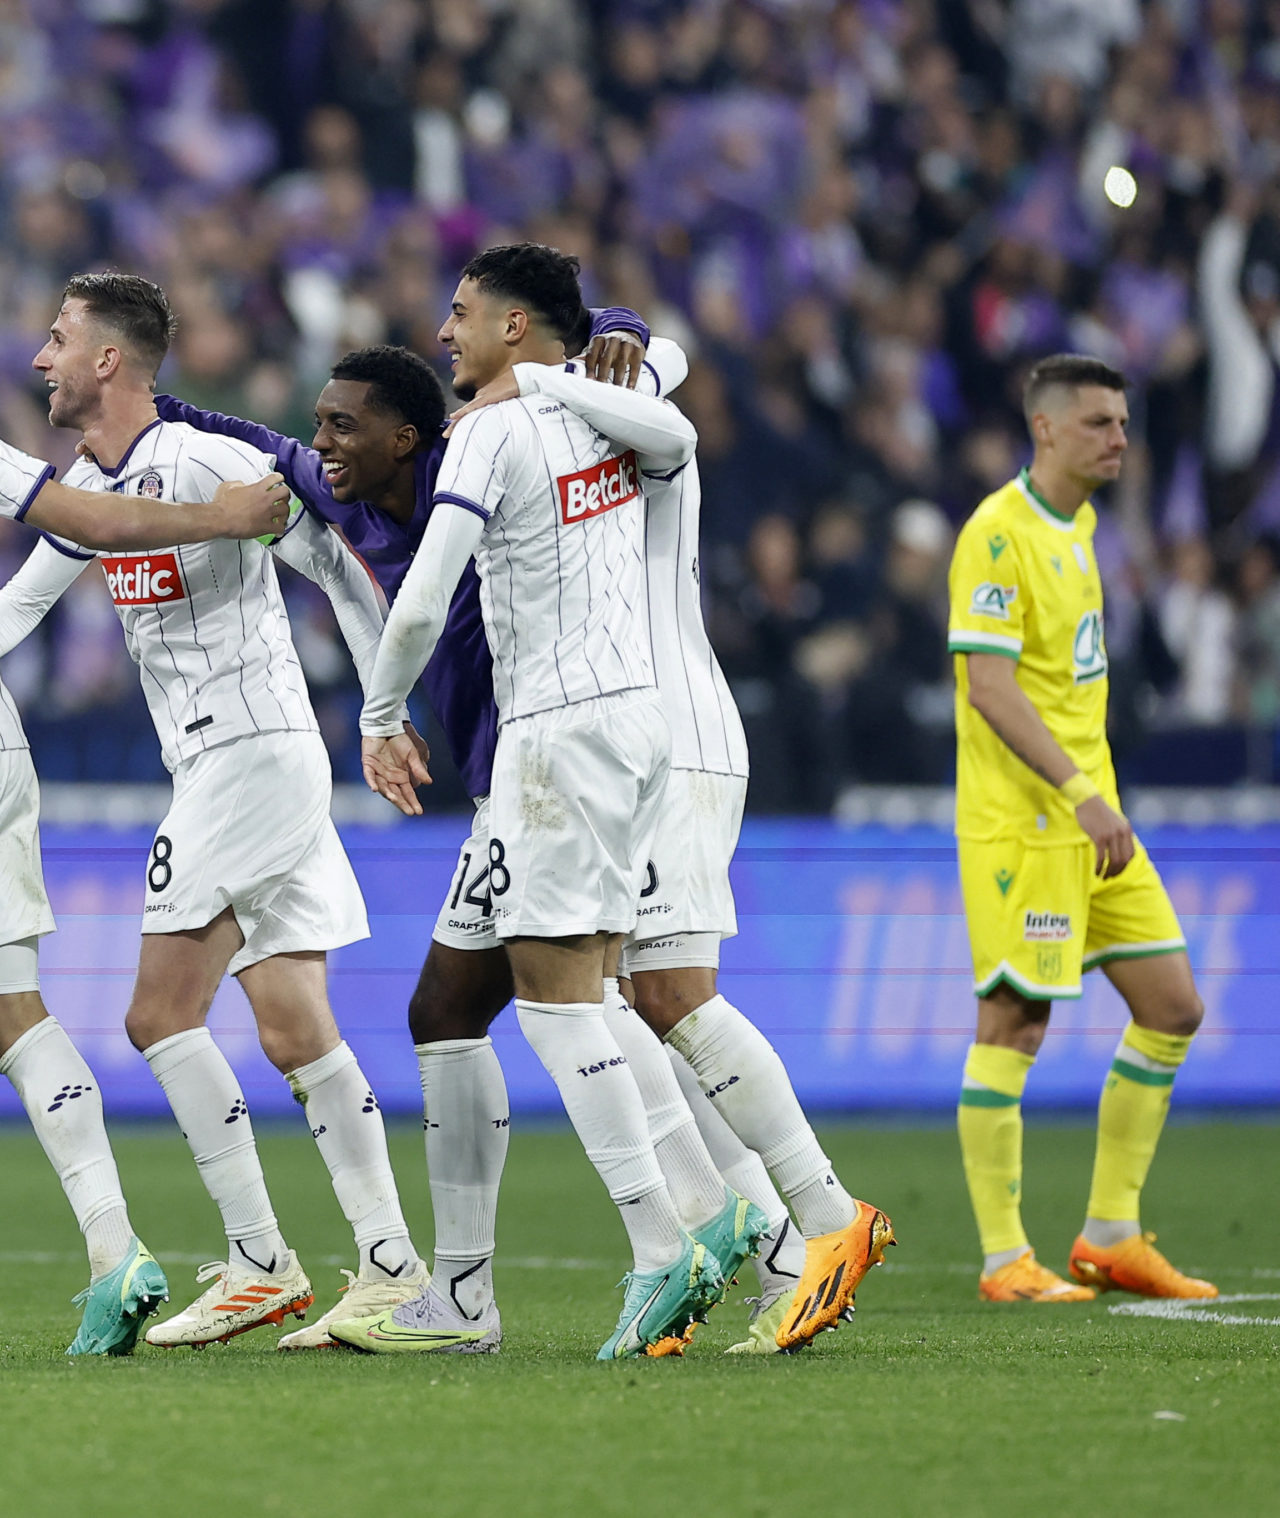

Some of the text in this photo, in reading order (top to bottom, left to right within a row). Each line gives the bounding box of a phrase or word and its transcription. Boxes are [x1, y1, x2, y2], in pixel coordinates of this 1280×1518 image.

[567, 458, 634, 518] Betclic
[148, 835, 172, 892] 8
[450, 853, 493, 917] 14
[489, 838, 511, 896] 8
[448, 920, 480, 931] CRAFT
[636, 905, 663, 917] RAFT
[639, 941, 674, 951] CRAFT
